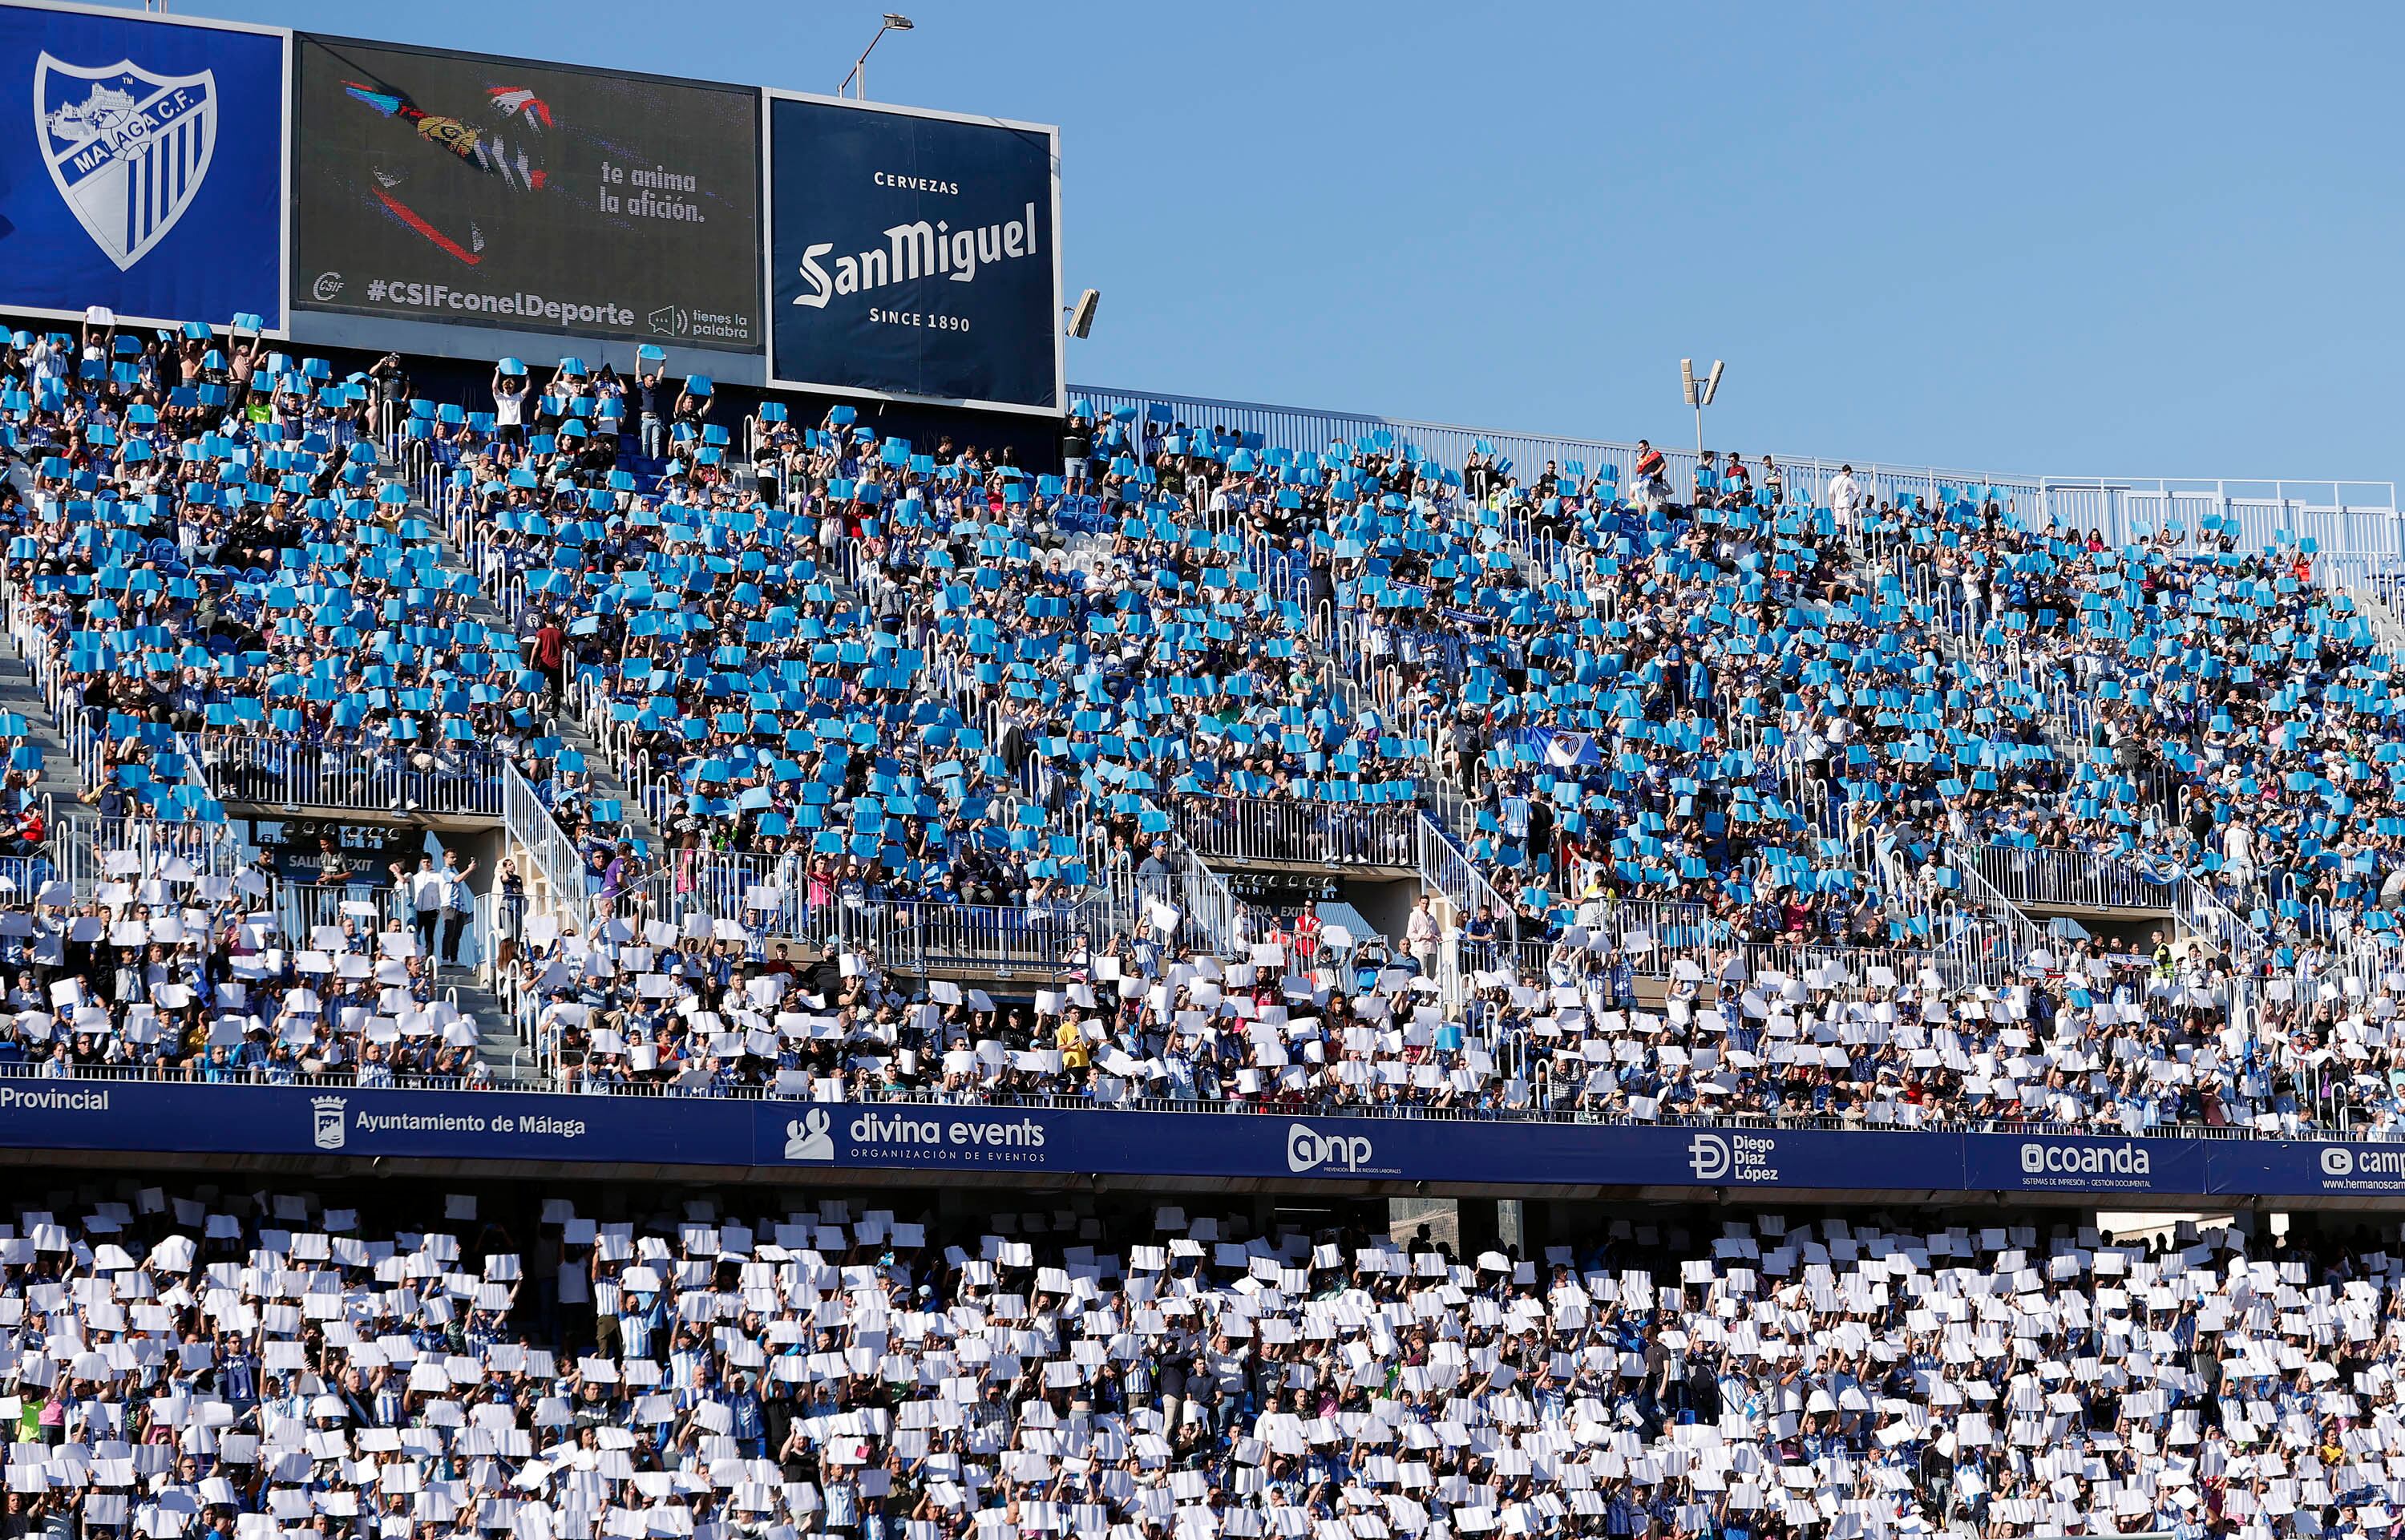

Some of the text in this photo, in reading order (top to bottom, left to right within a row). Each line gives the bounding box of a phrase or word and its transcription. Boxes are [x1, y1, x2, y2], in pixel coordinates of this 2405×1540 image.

[73, 90, 195, 174] MALAGA C.F.
[601, 161, 696, 192] te anima
[874, 172, 960, 195] CERVEZAS
[600, 185, 705, 223] la afición.
[320, 280, 345, 293] CSIF
[367, 279, 634, 325] #CSIFconelDeporte
[693, 309, 748, 326] tienes la
[869, 308, 970, 333] SINCE 1890
[693, 322, 748, 339] palabra
[0, 1087, 109, 1110] Provincial
[355, 1111, 585, 1138] Ayuntamiento de Málaga
[850, 1113, 1045, 1146] divina events
[851, 1148, 1045, 1162] ORGANIZACIÓN DE EVENTOS
[1732, 1135, 1775, 1153] Diego
[1734, 1150, 1766, 1165] Díaz
[2046, 1142, 2150, 1174] coanda
[1735, 1166, 1779, 1182] López
[2022, 1178, 2048, 1186] SISTEMAS
[2058, 1178, 2085, 1186] IMPRESIÓN
[2092, 1178, 2115, 1187] GESTIÓN
[2115, 1179, 2152, 1188] DOCUMENTAL
